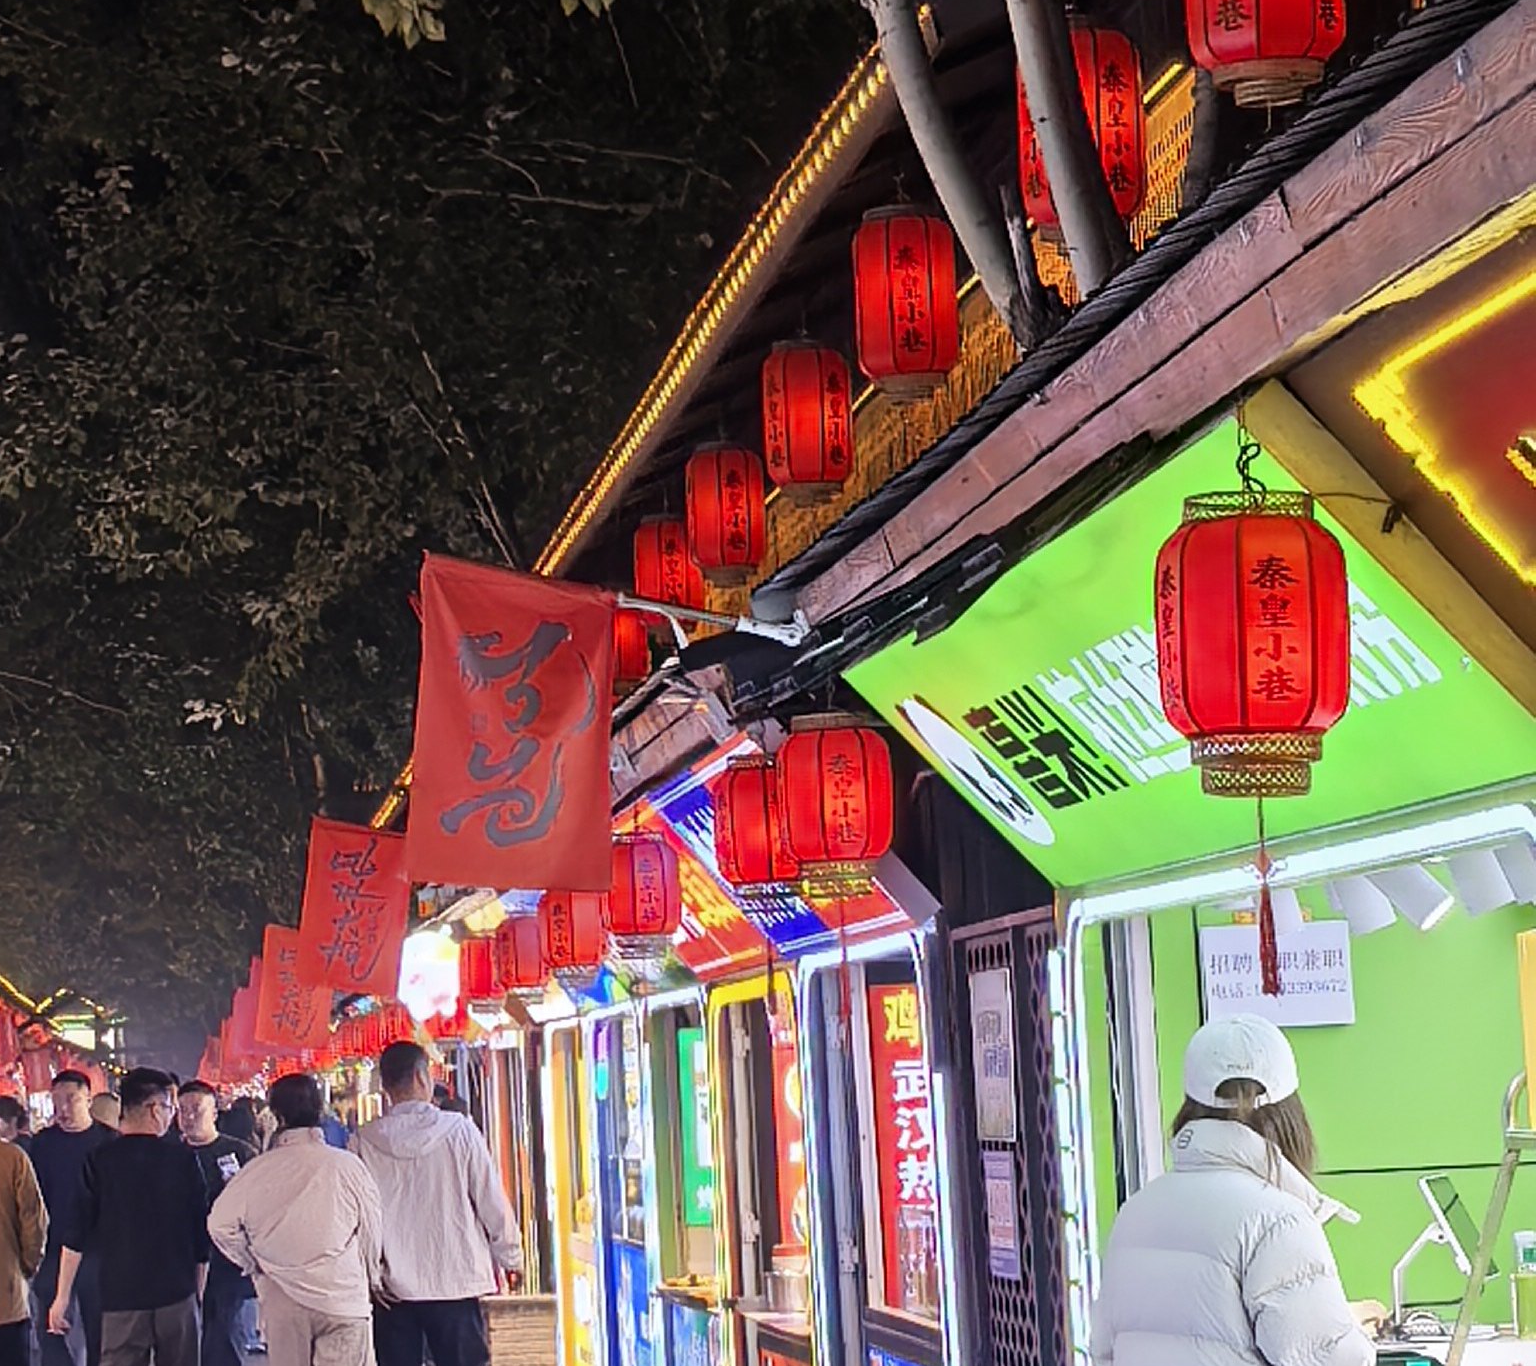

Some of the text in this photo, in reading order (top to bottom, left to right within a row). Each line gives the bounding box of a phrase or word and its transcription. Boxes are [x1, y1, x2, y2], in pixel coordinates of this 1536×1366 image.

[1101, 59, 1133, 193] 秦皇小巷
[893, 243, 928, 352] 秦皇小巷
[1248, 555, 1302, 703] 秦皇小巷
[827, 753, 860, 844] 秦皇小巷
[1209, 948, 1345, 975] 招聘职兼职
